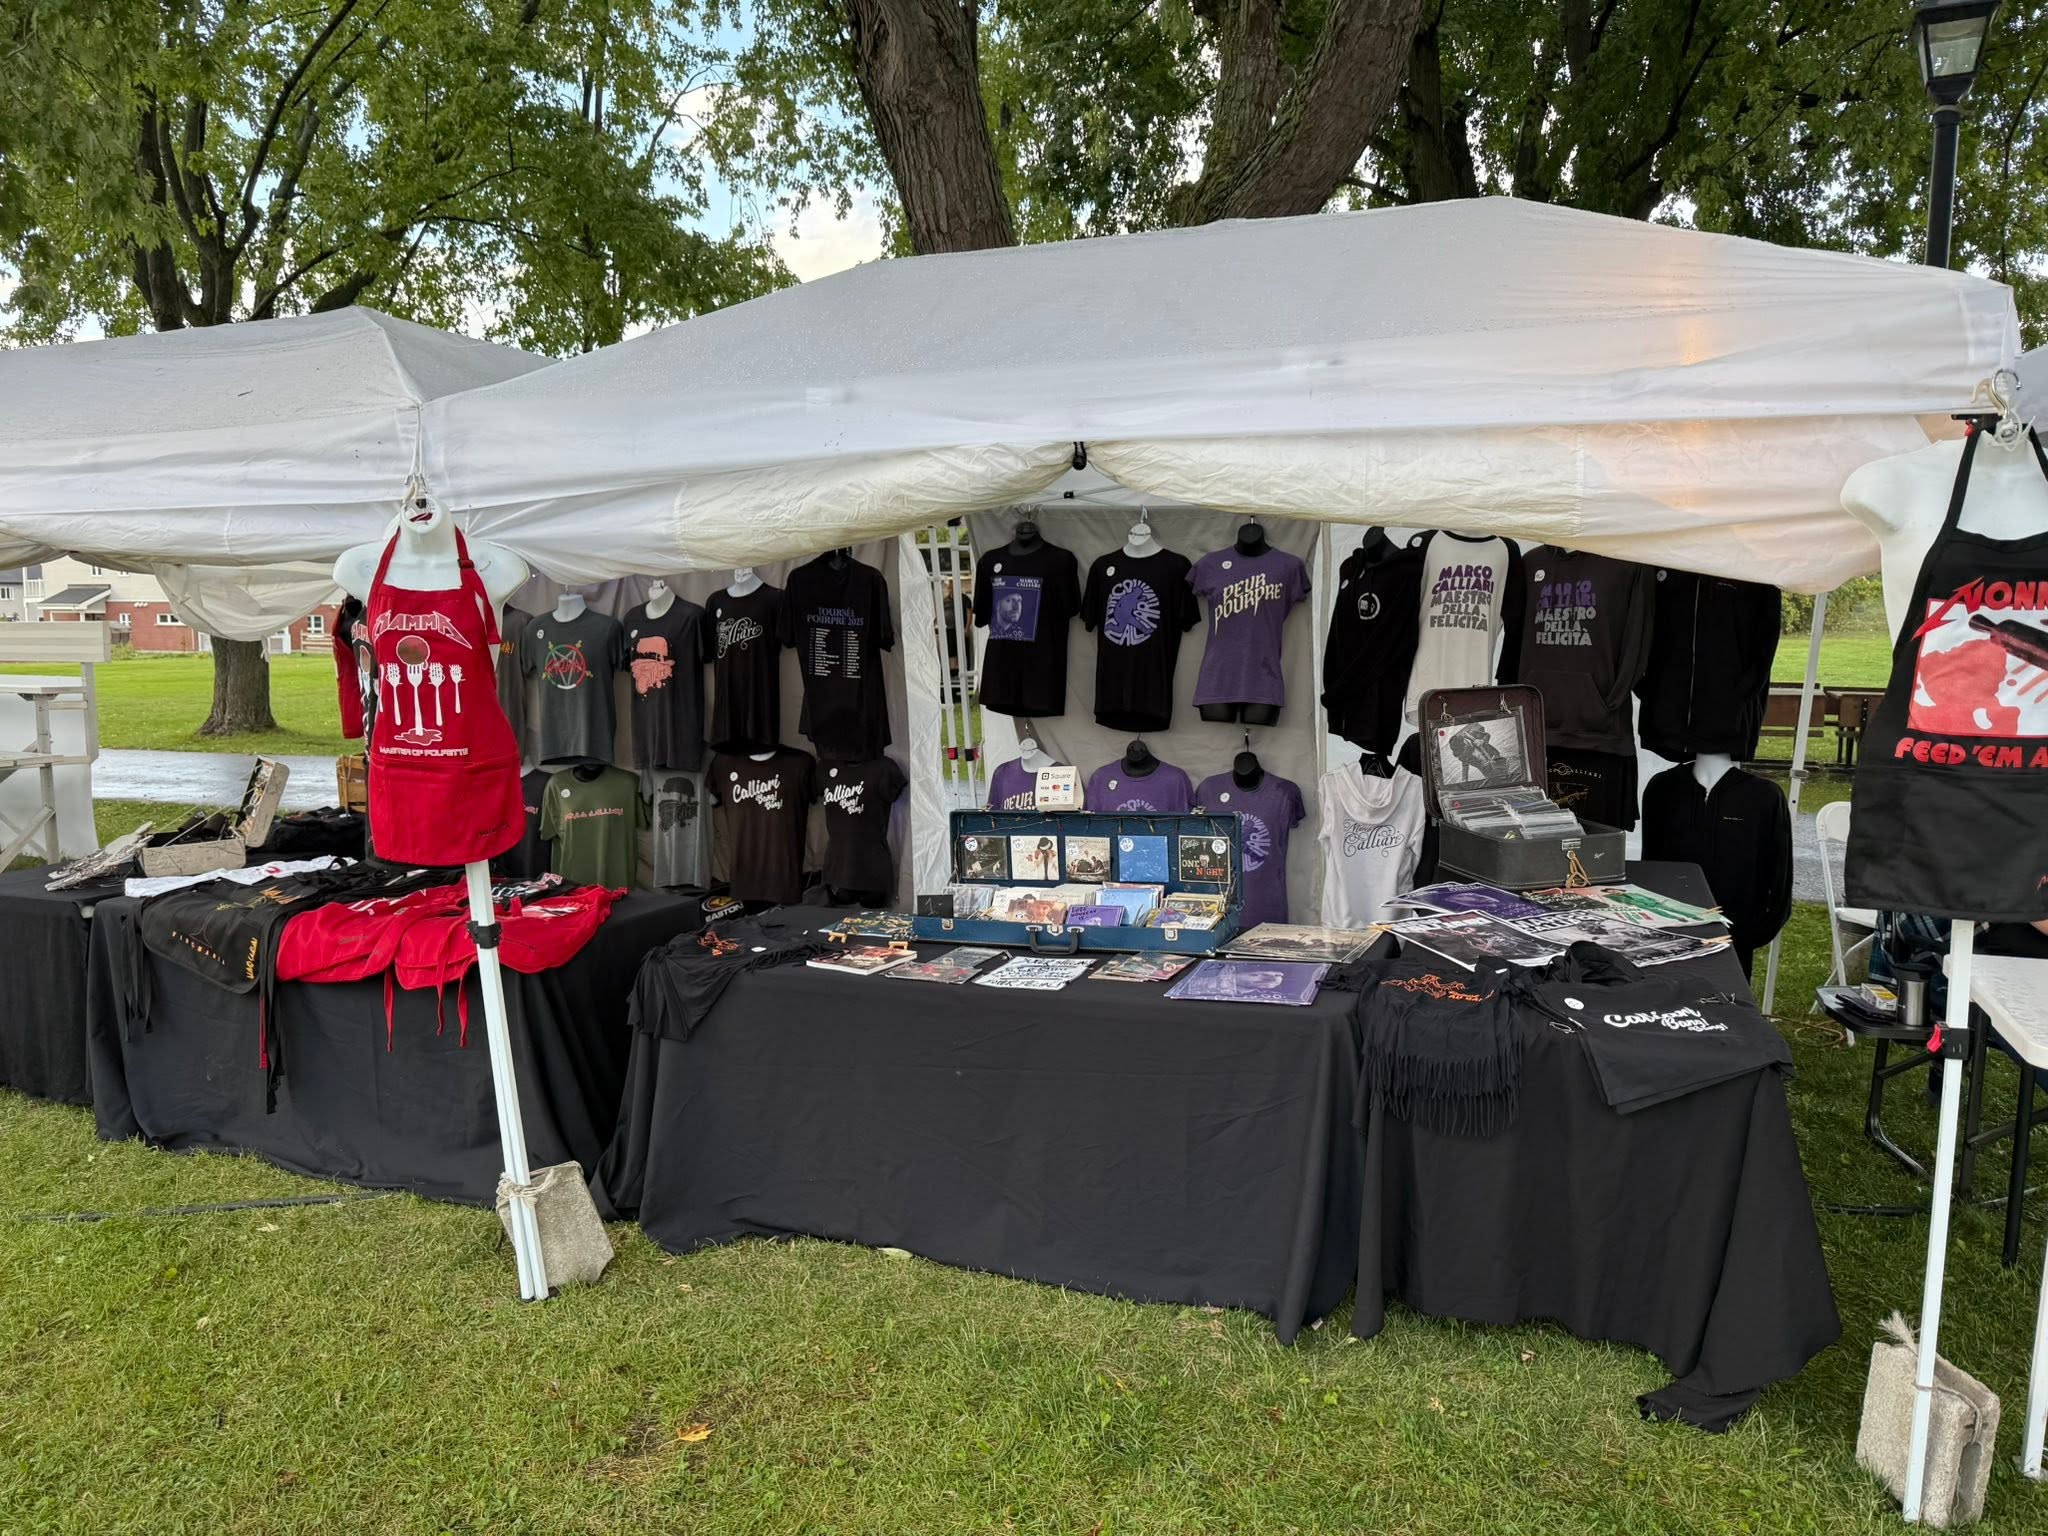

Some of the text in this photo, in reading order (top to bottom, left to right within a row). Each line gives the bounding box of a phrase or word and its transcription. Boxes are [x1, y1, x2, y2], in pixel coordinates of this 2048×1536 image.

[1439, 565, 1493, 581] MARCO
[1223, 573, 1266, 605] PEUR
[1432, 577, 1494, 595] CALLIARI
[1430, 590, 1492, 608] MAESTRO
[1214, 583, 1283, 636] POURPRE
[1442, 603, 1481, 616] DELLA
[1535, 606, 1597, 624] MAESTRO
[1430, 613, 1488, 632] FELICITÀ
[1544, 620, 1582, 632] DELLA
[1536, 627, 1592, 646] FELICITÀ
[379, 746, 411, 756] MASTER
[1895, 737, 1966, 765] FEED
[1972, 744, 2023, 768] 'EM
[733, 773, 781, 803] Calliari
[755, 790, 777, 805] Bang!
[1343, 824, 1405, 858] Calliari
[1182, 859, 1200, 868] ONE
[705, 902, 744, 922] EASTON
